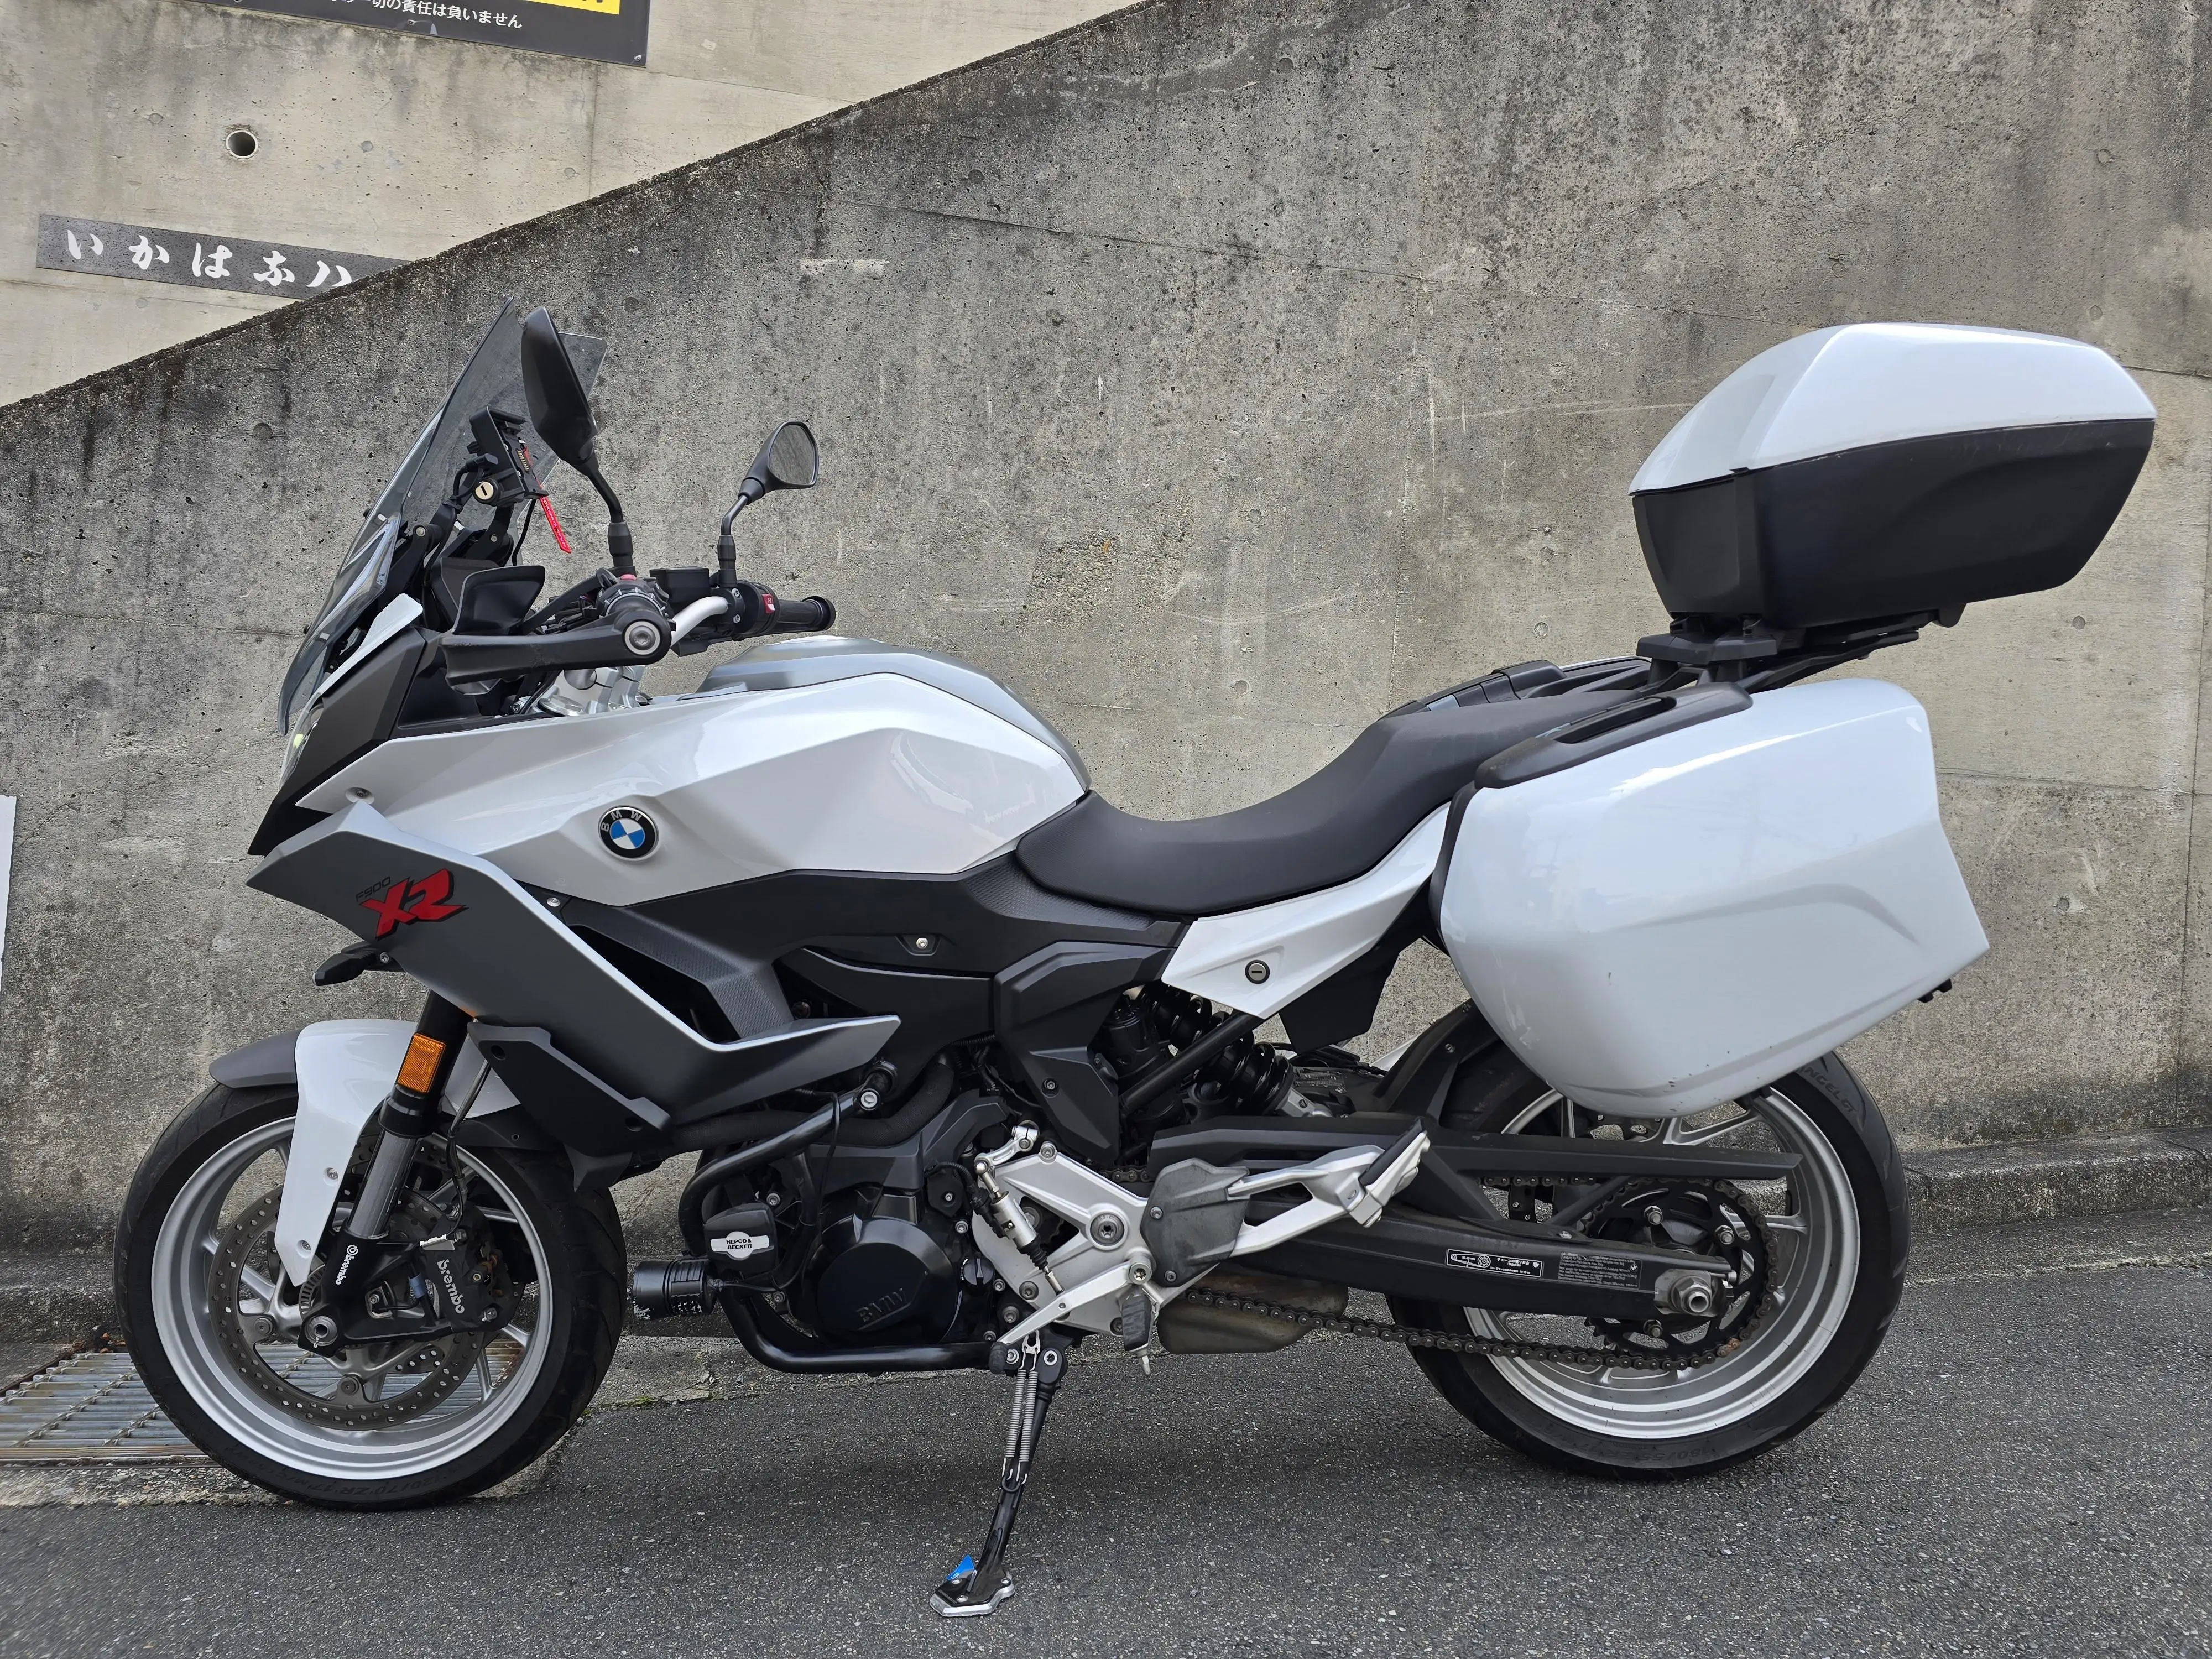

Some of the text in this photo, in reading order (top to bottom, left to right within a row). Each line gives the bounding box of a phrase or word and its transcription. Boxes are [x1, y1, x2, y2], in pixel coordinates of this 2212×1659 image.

[600, 810, 642, 832] BMW
[355, 875, 391, 902] F900
[359, 868, 469, 941] XR
[335, 1254, 355, 1285] brembo
[436, 1259, 465, 1314] brembo
